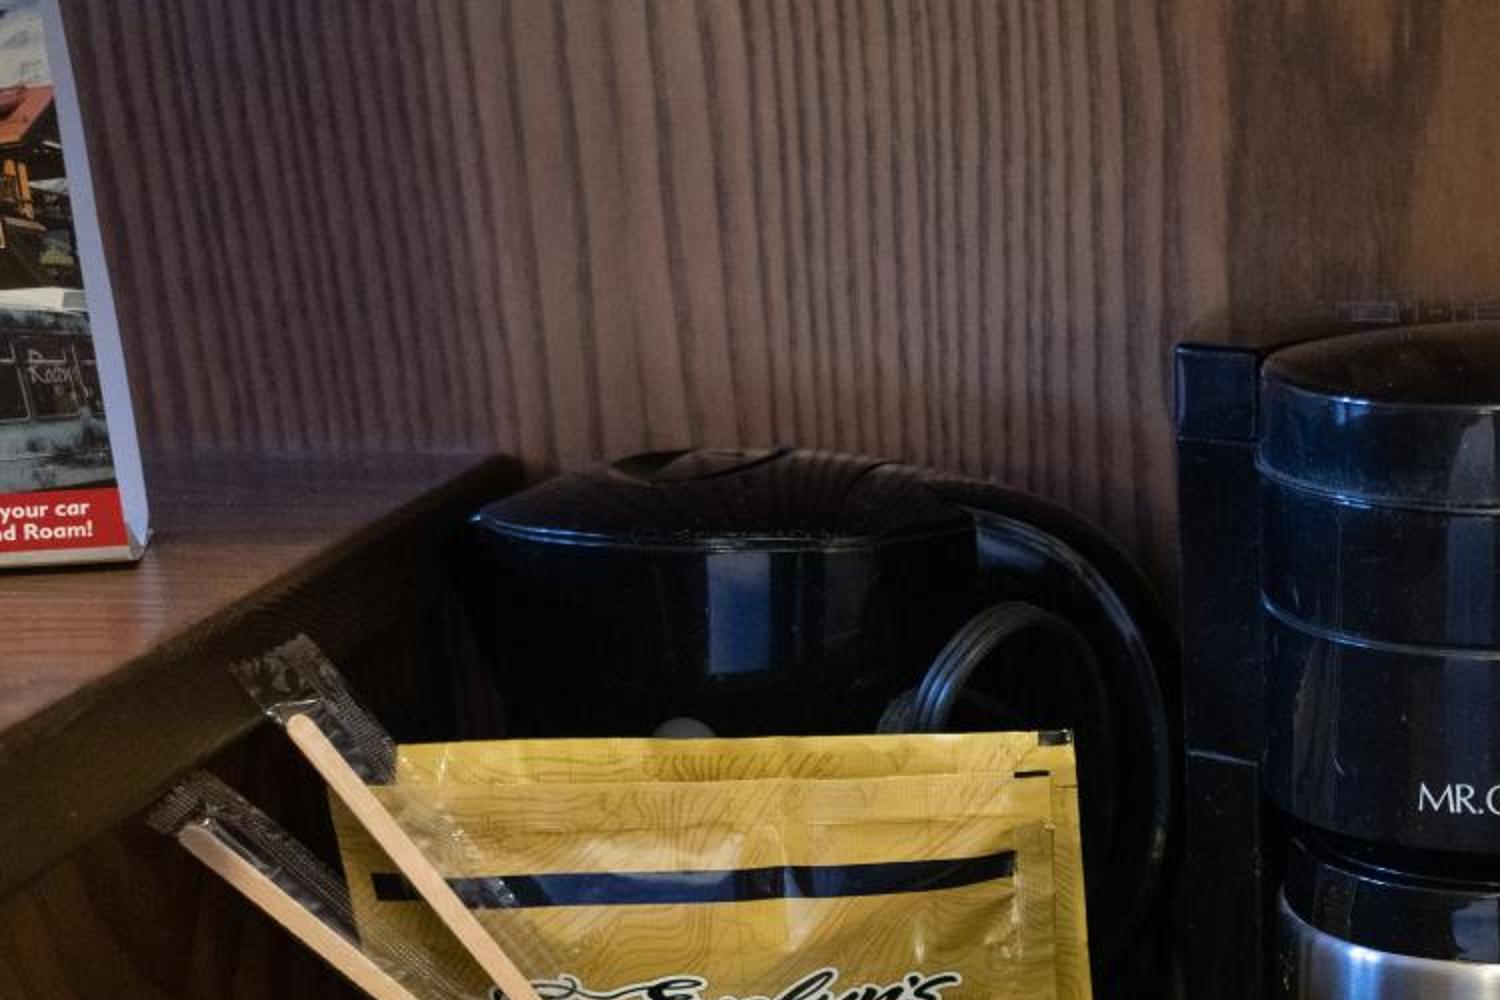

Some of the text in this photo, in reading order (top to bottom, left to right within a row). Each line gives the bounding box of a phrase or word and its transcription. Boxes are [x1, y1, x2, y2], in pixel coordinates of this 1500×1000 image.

[0, 503, 91, 525] your car
[23, 520, 94, 541] Roam!
[1418, 782, 1484, 815] MR.
